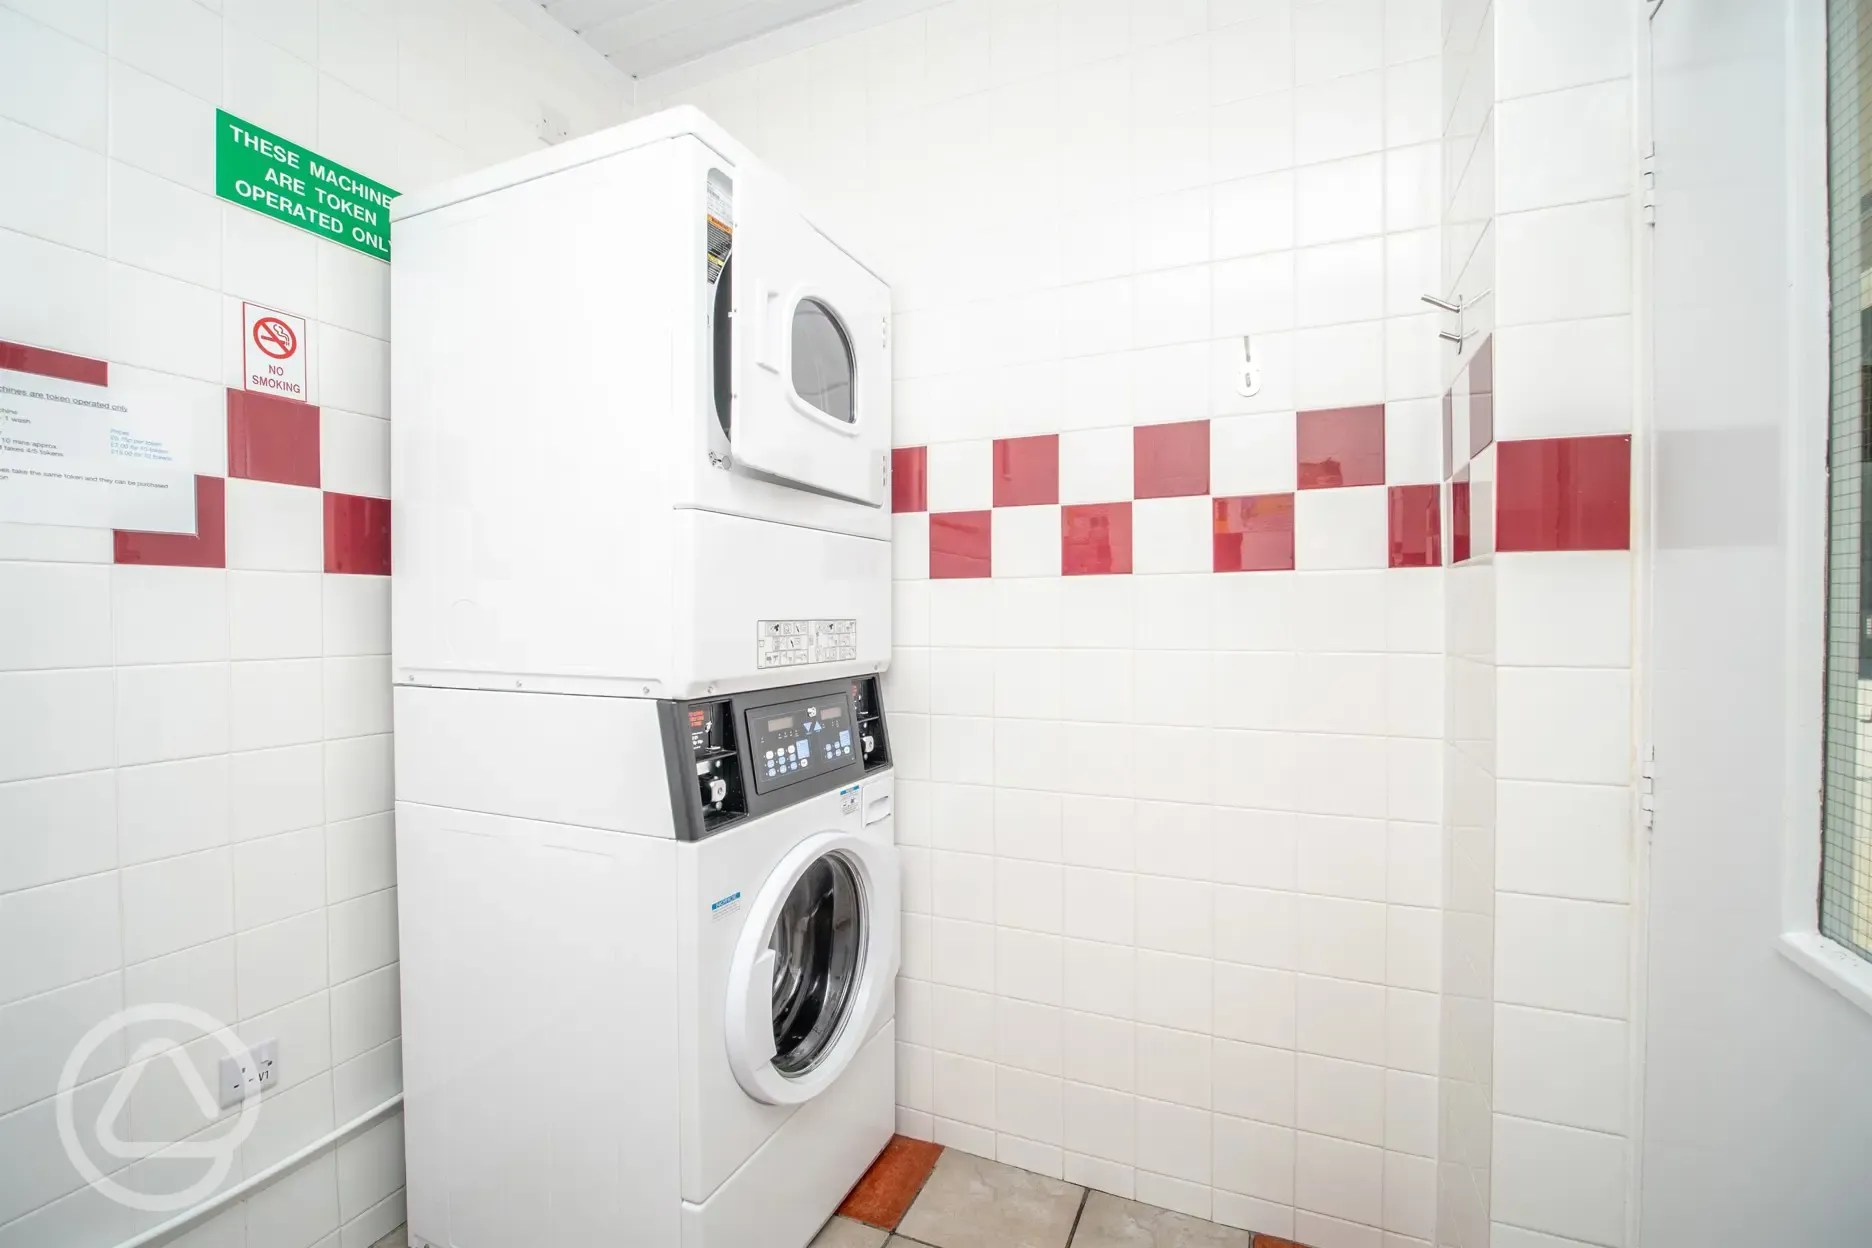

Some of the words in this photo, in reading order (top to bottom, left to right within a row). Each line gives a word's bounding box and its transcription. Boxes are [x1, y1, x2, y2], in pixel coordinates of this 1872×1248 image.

[229, 124, 300, 169] THESE
[235, 180, 344, 234] OPERATED
[264, 168, 306, 196] ARE
[315, 187, 377, 226] TOKEN
[268, 364, 284, 376] NO
[252, 374, 301, 394] SMOKING
[29, 390, 44, 399] are
[46, 393, 71, 403] token
[72, 398, 110, 411] operated
[111, 404, 128, 413] only
[64, 473, 84, 481] token
[99, 477, 113, 485] they
